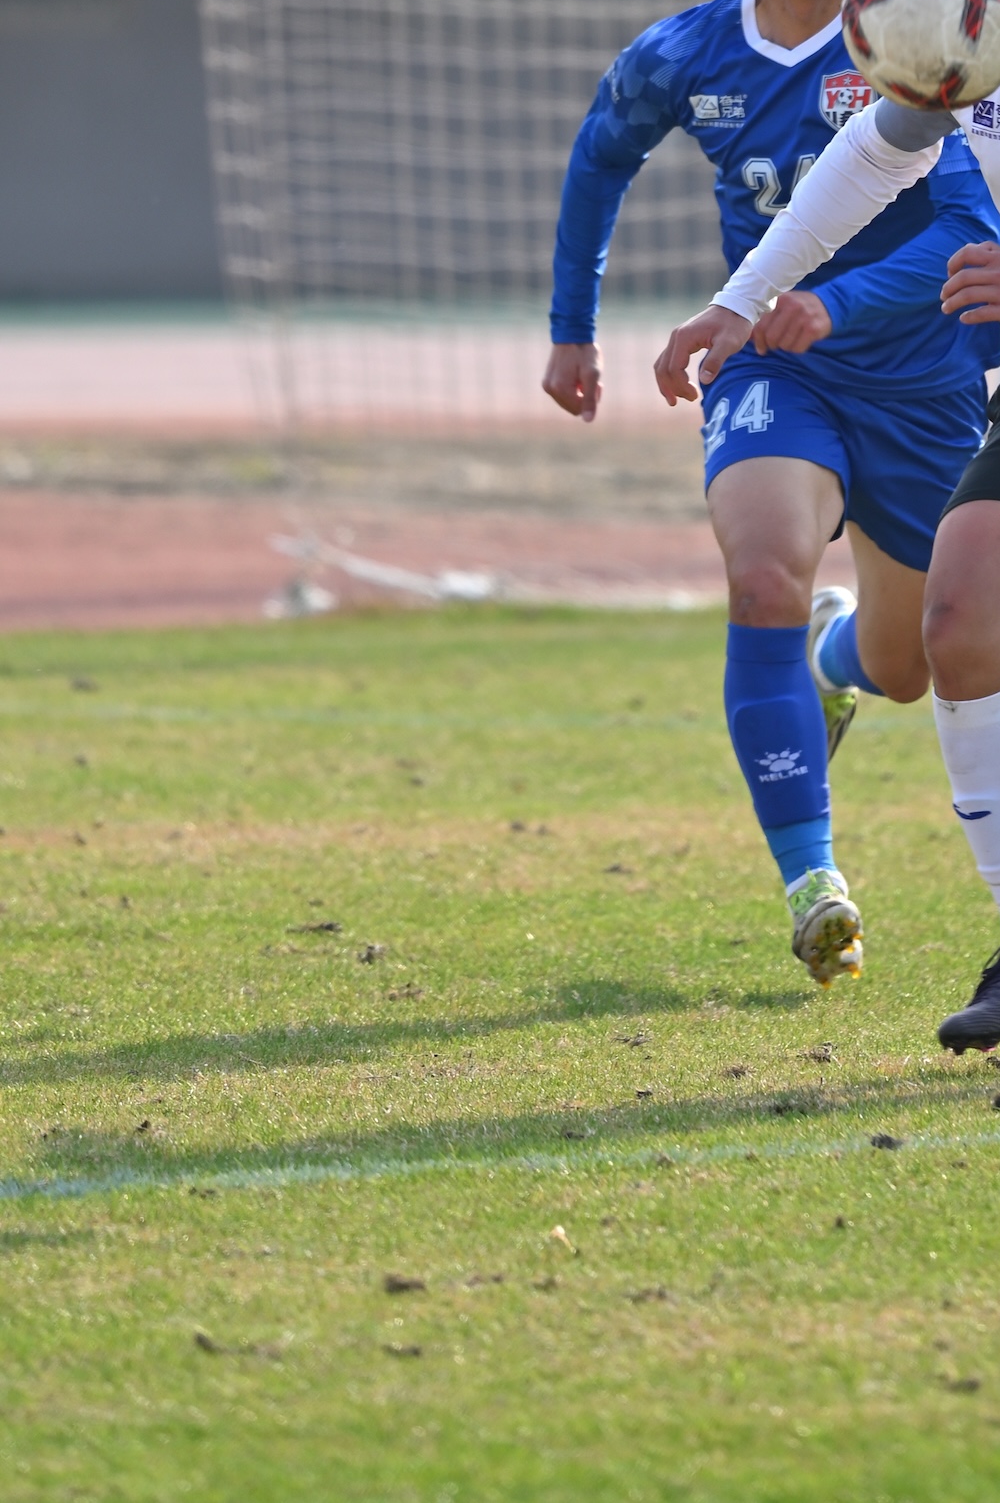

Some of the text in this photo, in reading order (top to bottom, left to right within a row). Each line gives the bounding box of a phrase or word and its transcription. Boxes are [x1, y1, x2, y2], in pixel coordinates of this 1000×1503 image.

[742, 153, 816, 217] 2
[702, 380, 775, 461] 24
[759, 765, 809, 783] KELME
